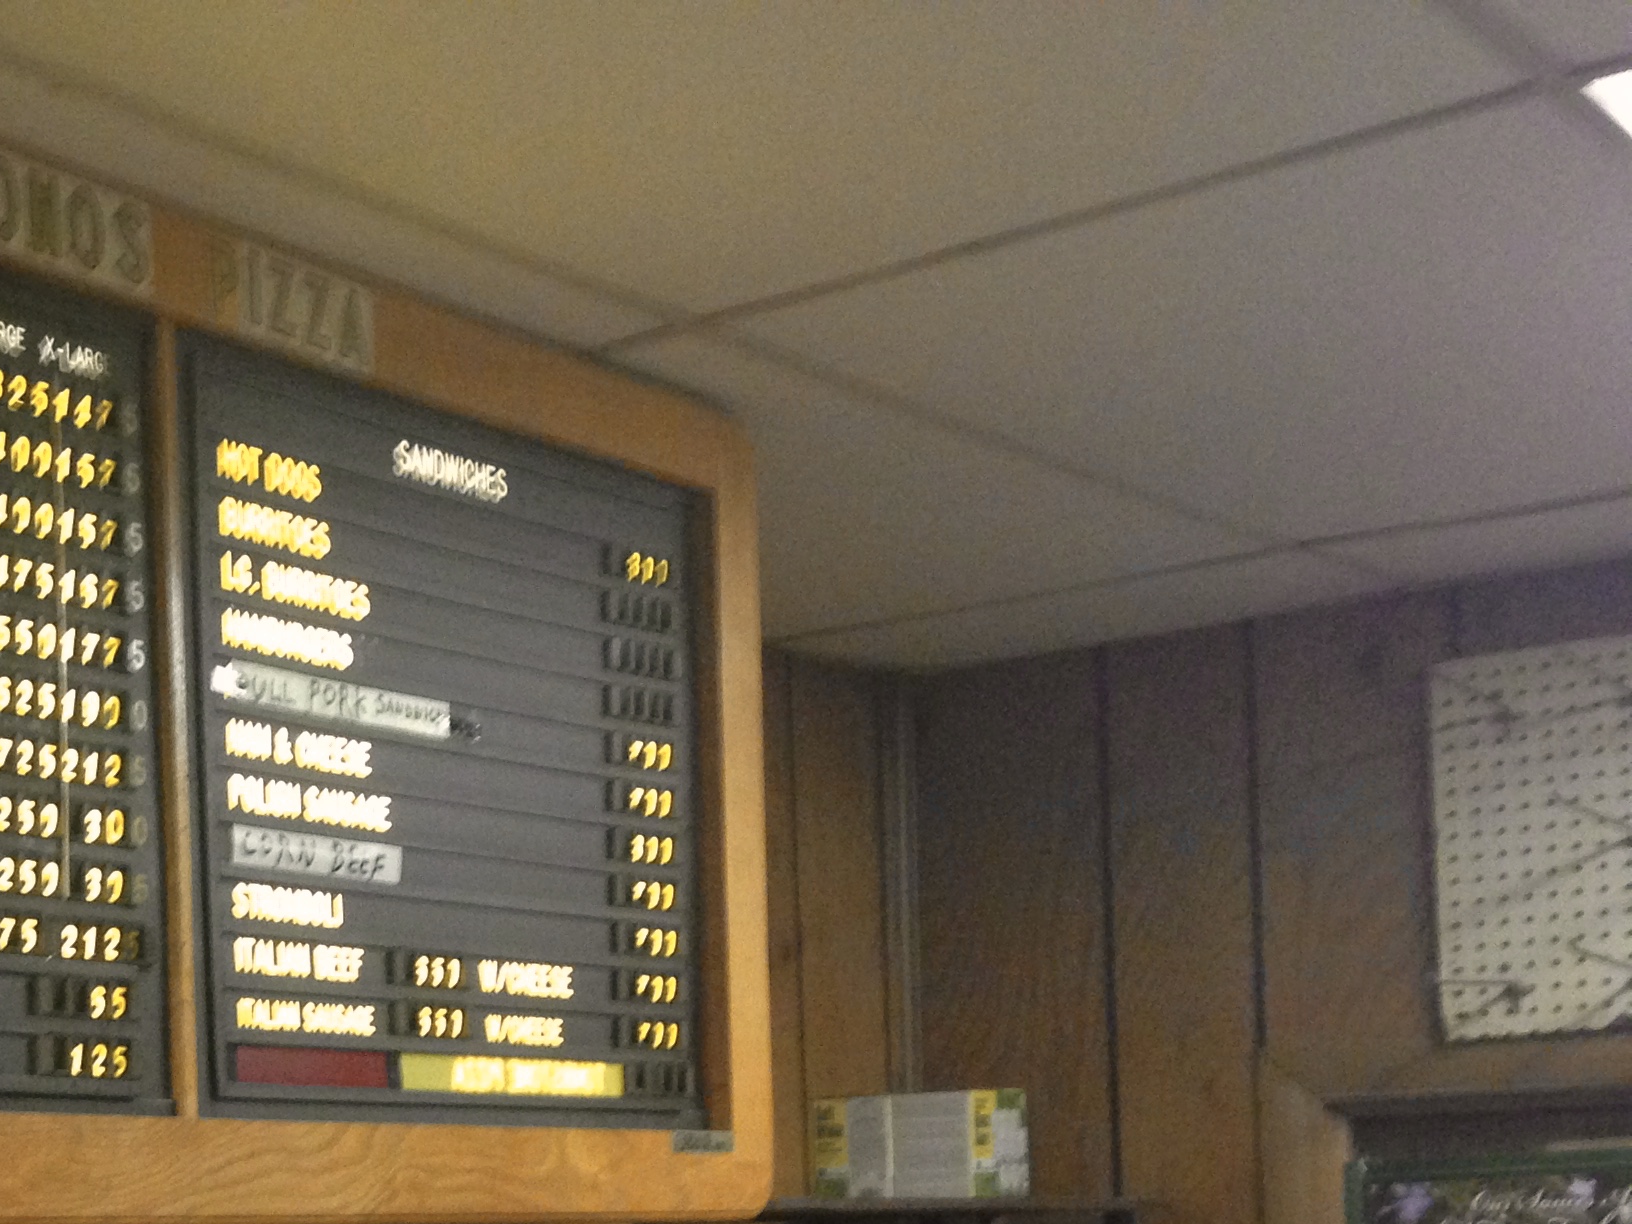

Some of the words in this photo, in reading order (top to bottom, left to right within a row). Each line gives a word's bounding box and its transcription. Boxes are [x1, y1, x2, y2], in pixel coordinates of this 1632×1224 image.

[217, 438, 263, 485] HOT
[264, 452, 322, 502] DOGS
[392, 440, 508, 503] SANDWICHES
[233, 937, 311, 978] ITALIAN
[313, 944, 364, 982] BEEF
[70, 1043, 128, 1079] 125
